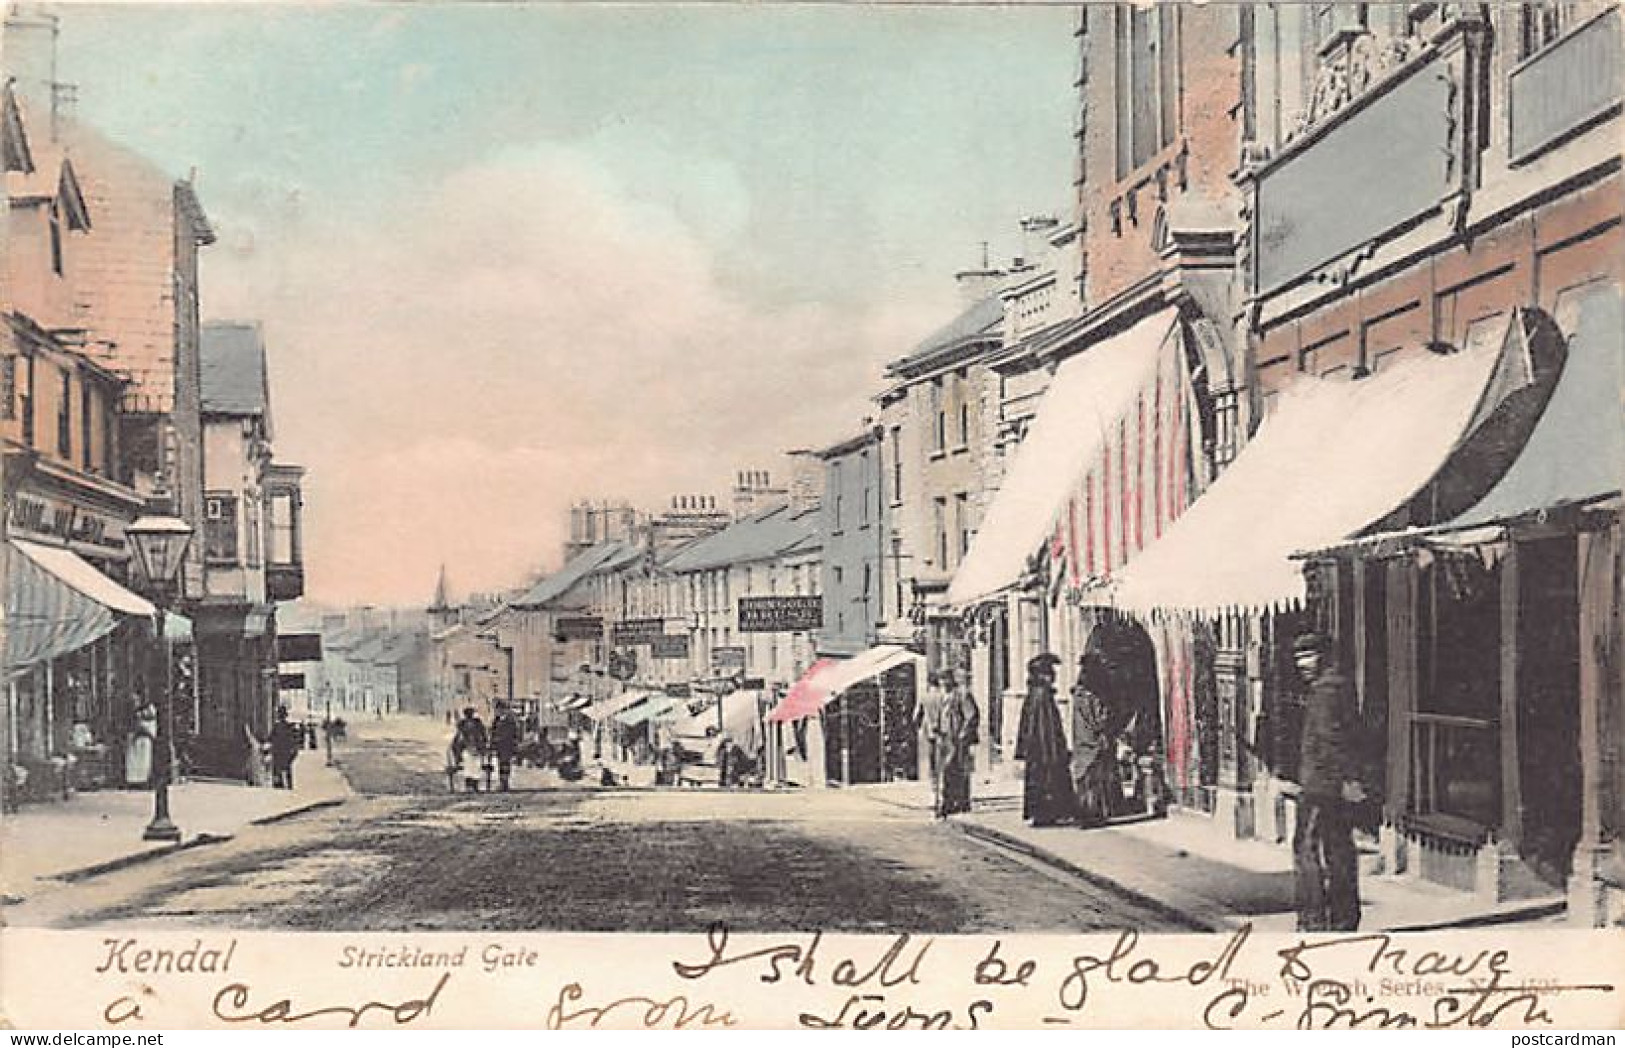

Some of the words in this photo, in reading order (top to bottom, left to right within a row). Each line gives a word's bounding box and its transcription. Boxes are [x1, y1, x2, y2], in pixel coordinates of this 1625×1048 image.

[95, 939, 237, 973] Kendal
[338, 945, 468, 968] Strickland
[481, 945, 539, 970] Gate
[760, 931, 934, 986] shall
[974, 941, 1037, 985] be
[1060, 924, 1252, 1011] glad
[1369, 934, 1513, 978] have
[104, 996, 144, 1024] a
[213, 973, 451, 1025] card
[546, 983, 737, 1029] from
[1226, 978, 1270, 998] The
[1380, 979, 1444, 998] Series
